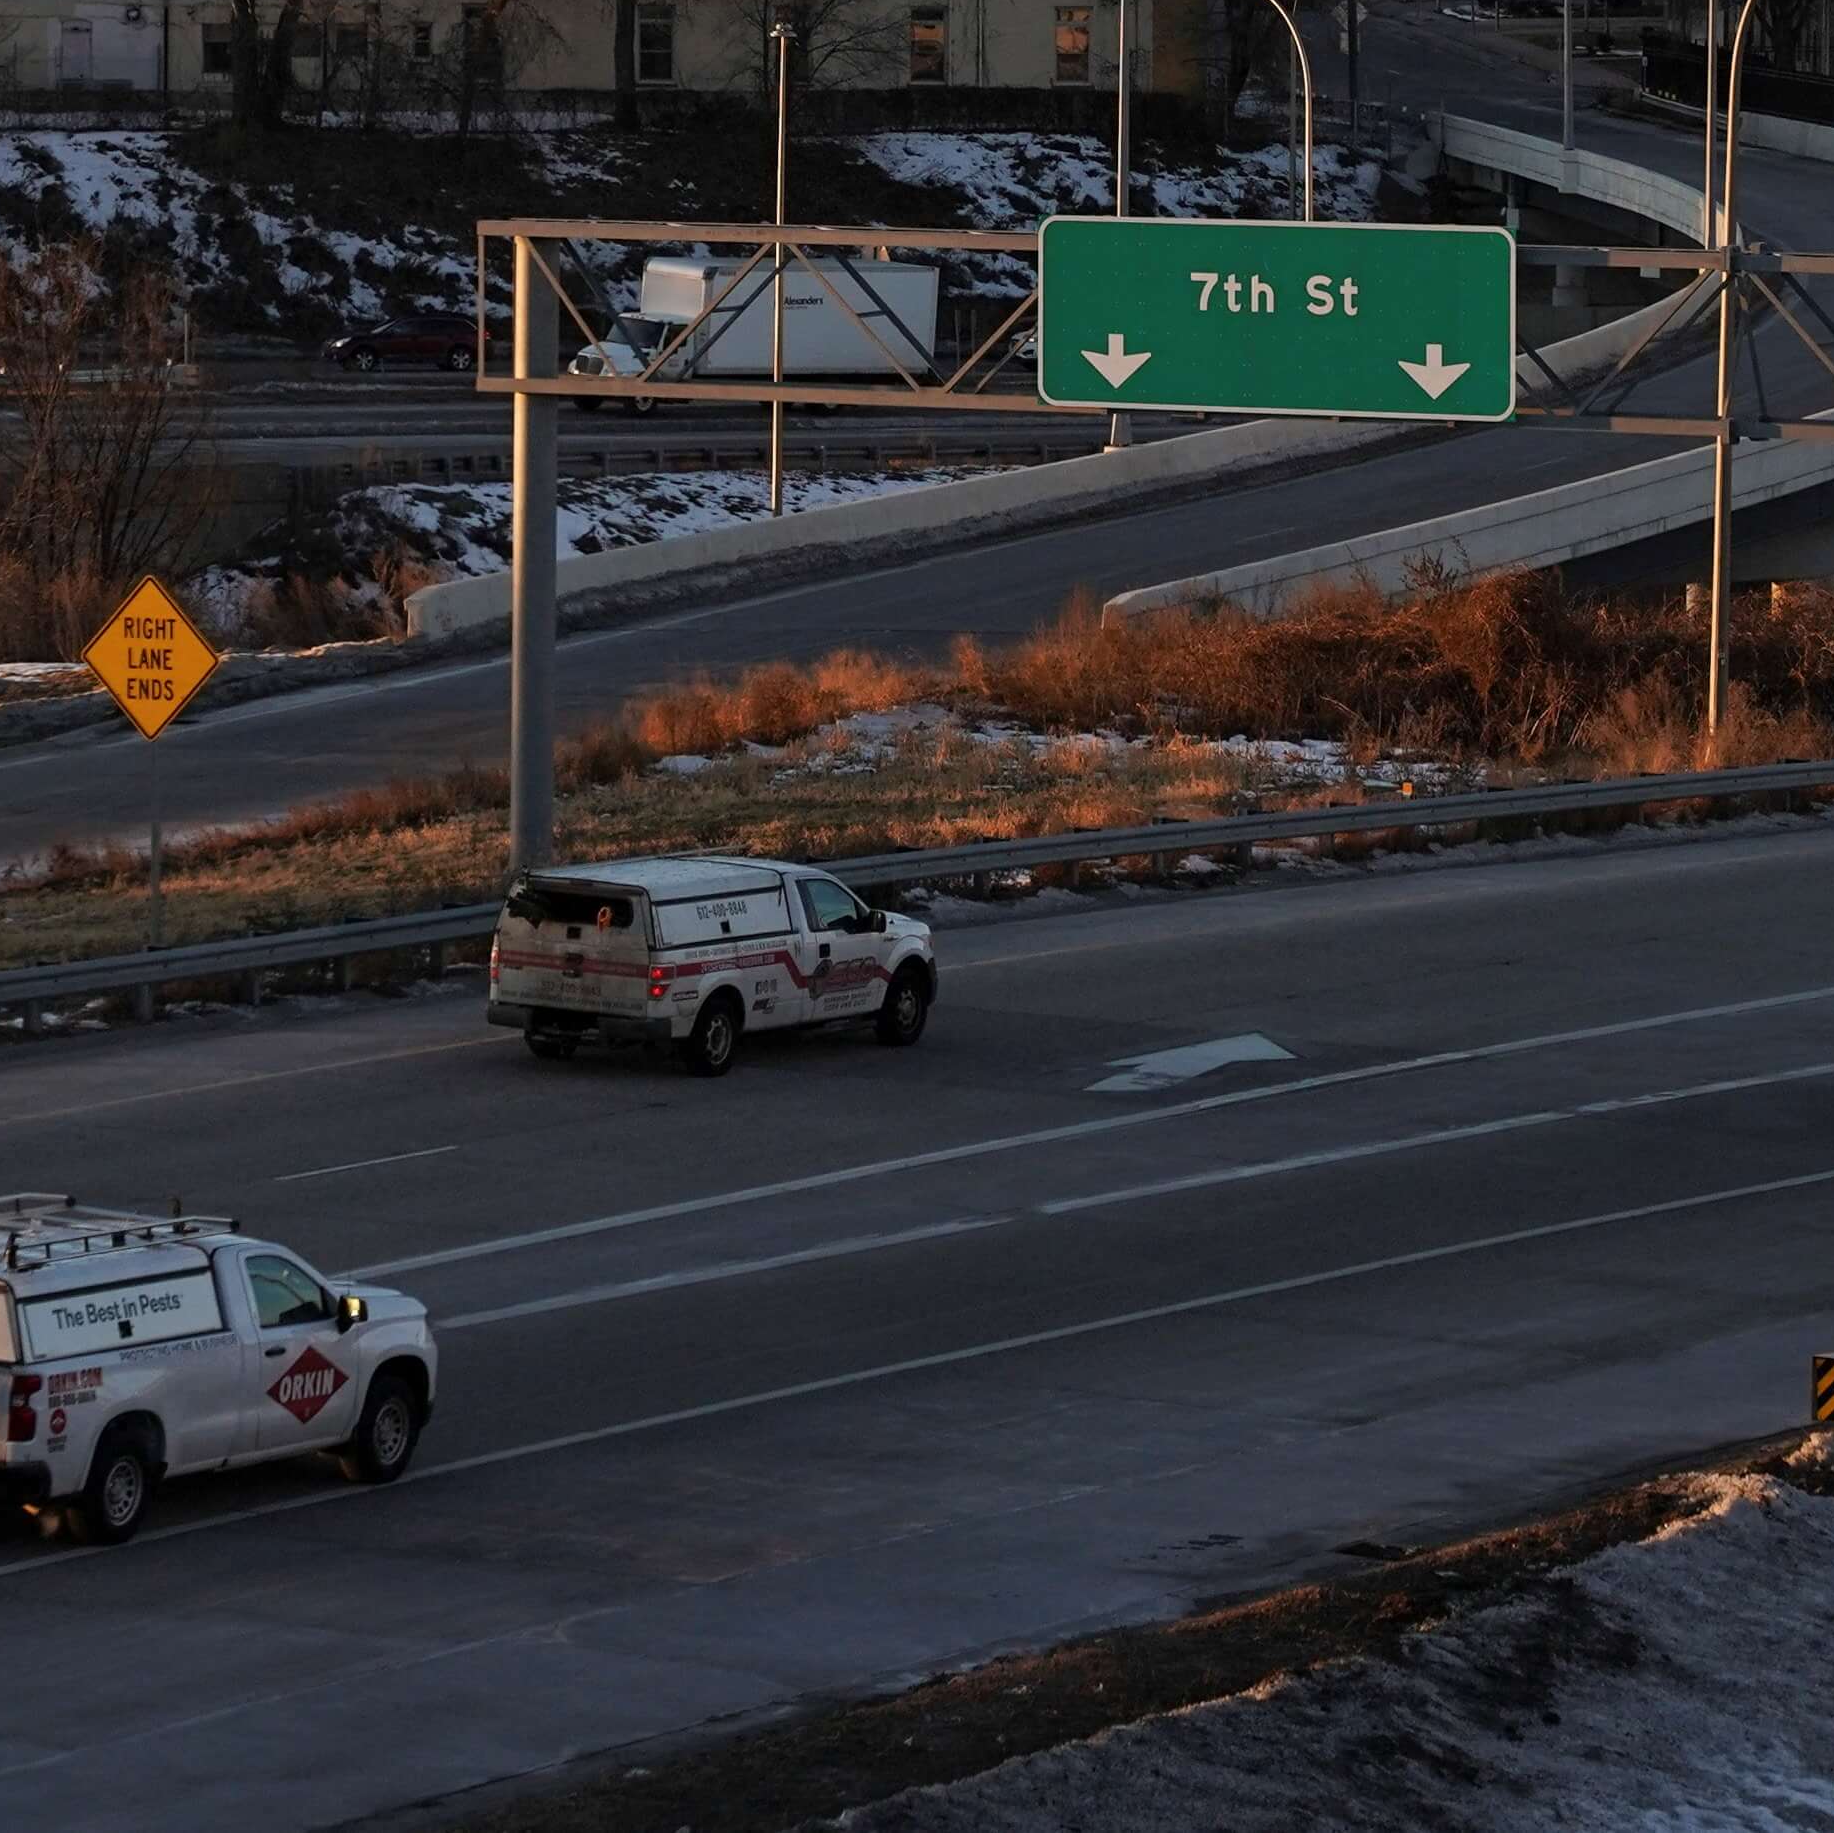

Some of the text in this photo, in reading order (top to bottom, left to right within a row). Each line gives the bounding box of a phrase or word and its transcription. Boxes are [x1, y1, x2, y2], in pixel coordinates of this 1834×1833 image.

[783, 295, 823, 305] Alexanders
[1191, 272, 1358, 316] 7th St
[124, 618, 177, 640] RIGHT
[128, 647, 173, 671] LANE
[127, 678, 174, 701] ENDS
[52, 1293, 181, 1329] The Best in Pests
[48, 1367, 103, 1394] ORKIN.COM
[279, 1367, 335, 1403] ORKIN
